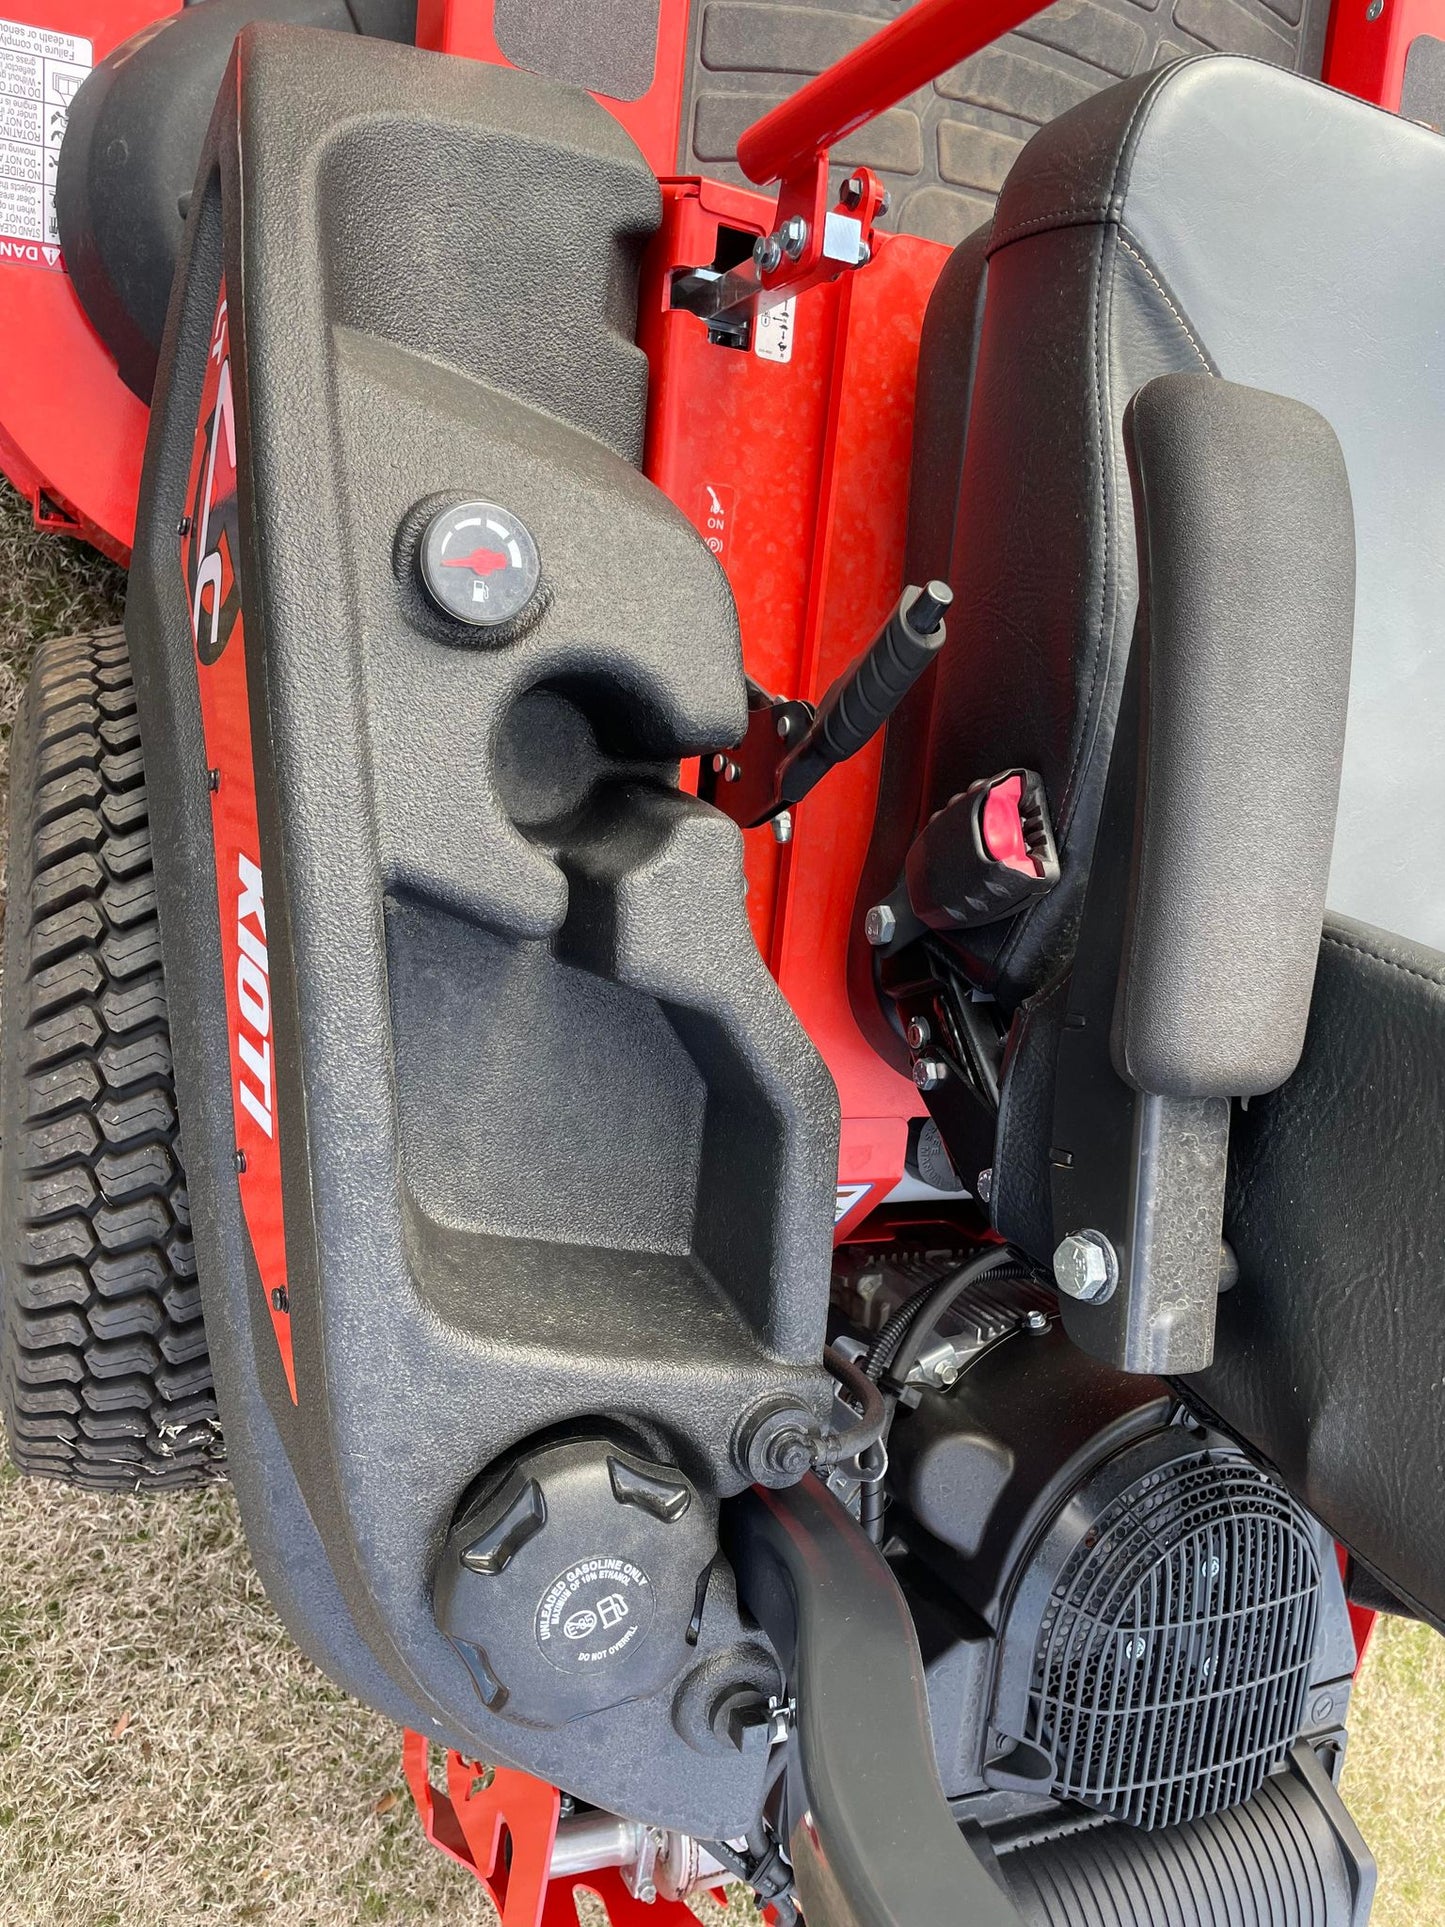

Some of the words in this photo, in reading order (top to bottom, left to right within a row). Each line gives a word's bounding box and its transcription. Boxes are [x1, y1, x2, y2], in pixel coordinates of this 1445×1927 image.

[27, 30, 37, 40] or
[39, 32, 64, 46] death
[34, 44, 42, 54] to
[66, 39, 74, 49] in
[44, 45, 75, 60] Failure
[16, 56, 36, 67] grass
[5, 61, 36, 77] deflector
[7, 73, 36, 87] Without
[8, 84, 26, 95] NOT
[28, 87, 41, 98] DO
[5, 98, 11, 107] is
[13, 99, 38, 111] engine
[7, 108, 15, 116] or
[16, 109, 37, 120] under
[5, 117, 22, 128] NOT
[24, 120, 36, 130] DO
[8, 143, 36, 157] mowing
[5, 154, 22, 166] NOT
[24, 158, 36, 168] DO
[27, 169, 41, 180] NO
[10, 181, 36, 194] objects
[16, 194, 36, 206] Clear
[8, 204, 15, 212] in
[16, 205, 36, 215] when
[5, 213, 22, 224] NOT
[23, 216, 35, 226] DO
[19, 225, 40, 238] STAND
[0, 241, 38, 261] DAN
[706, 517, 724, 530] ON
[237, 851, 273, 1139] KIOTI
[540, 1580, 566, 1640] UNLEADED
[567, 1559, 623, 1582] GASOLINE
[624, 1565, 648, 1586] ONLY
[551, 1587, 572, 1624] MAXIMUM
[571, 1580, 581, 1591] OF
[582, 1572, 598, 1583] 10%
[599, 1570, 631, 1586] ETHANOL
[578, 1653, 590, 1661] DO
[591, 1650, 607, 1661] NOT
[608, 1625, 638, 1654] OVERFILL
